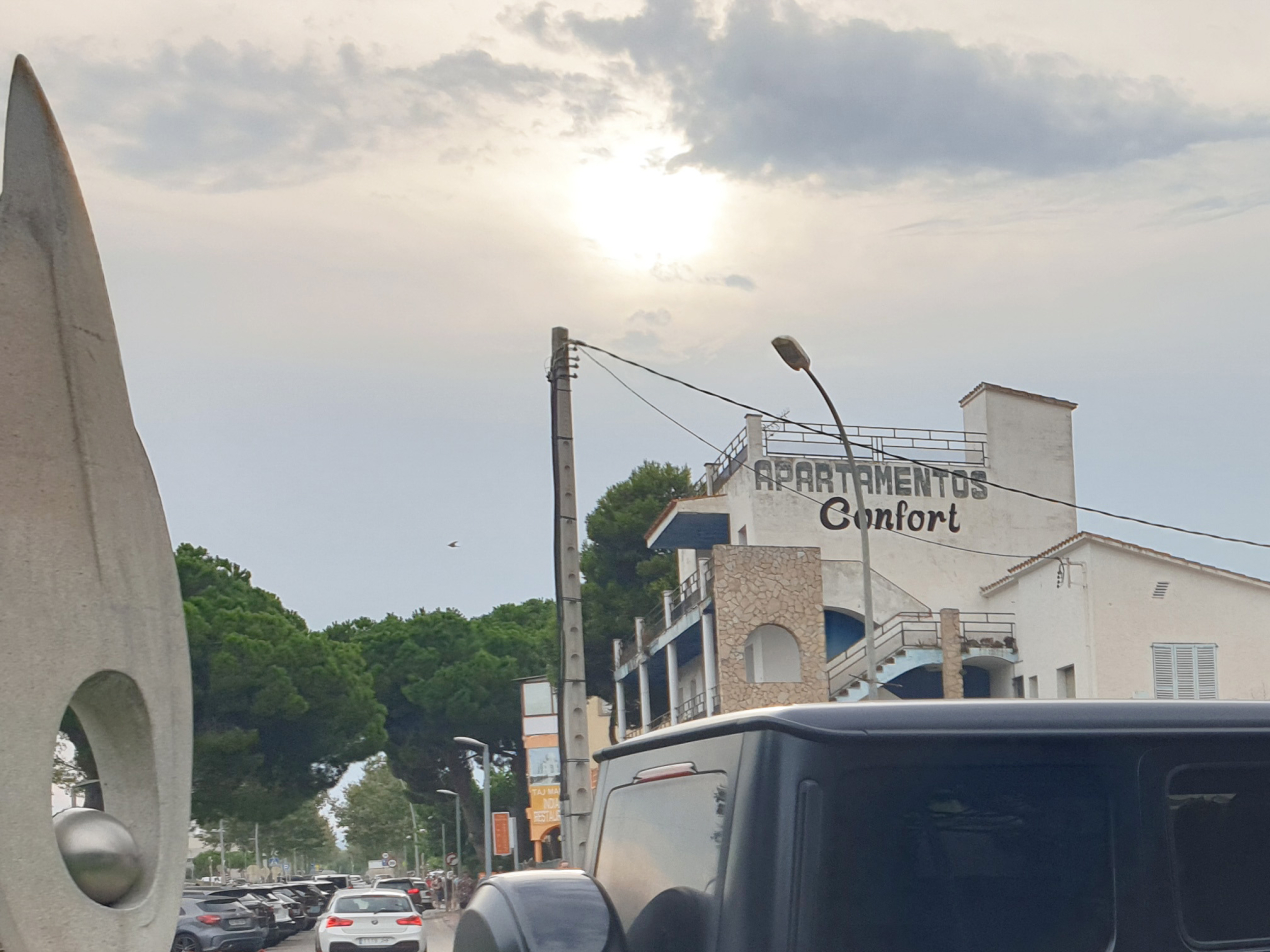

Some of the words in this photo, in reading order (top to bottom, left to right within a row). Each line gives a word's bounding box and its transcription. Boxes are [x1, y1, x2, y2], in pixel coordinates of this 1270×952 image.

[754, 459, 988, 500] APARTAMENTOS
[820, 496, 960, 533] Confort
[532, 788, 546, 796] TAJ
